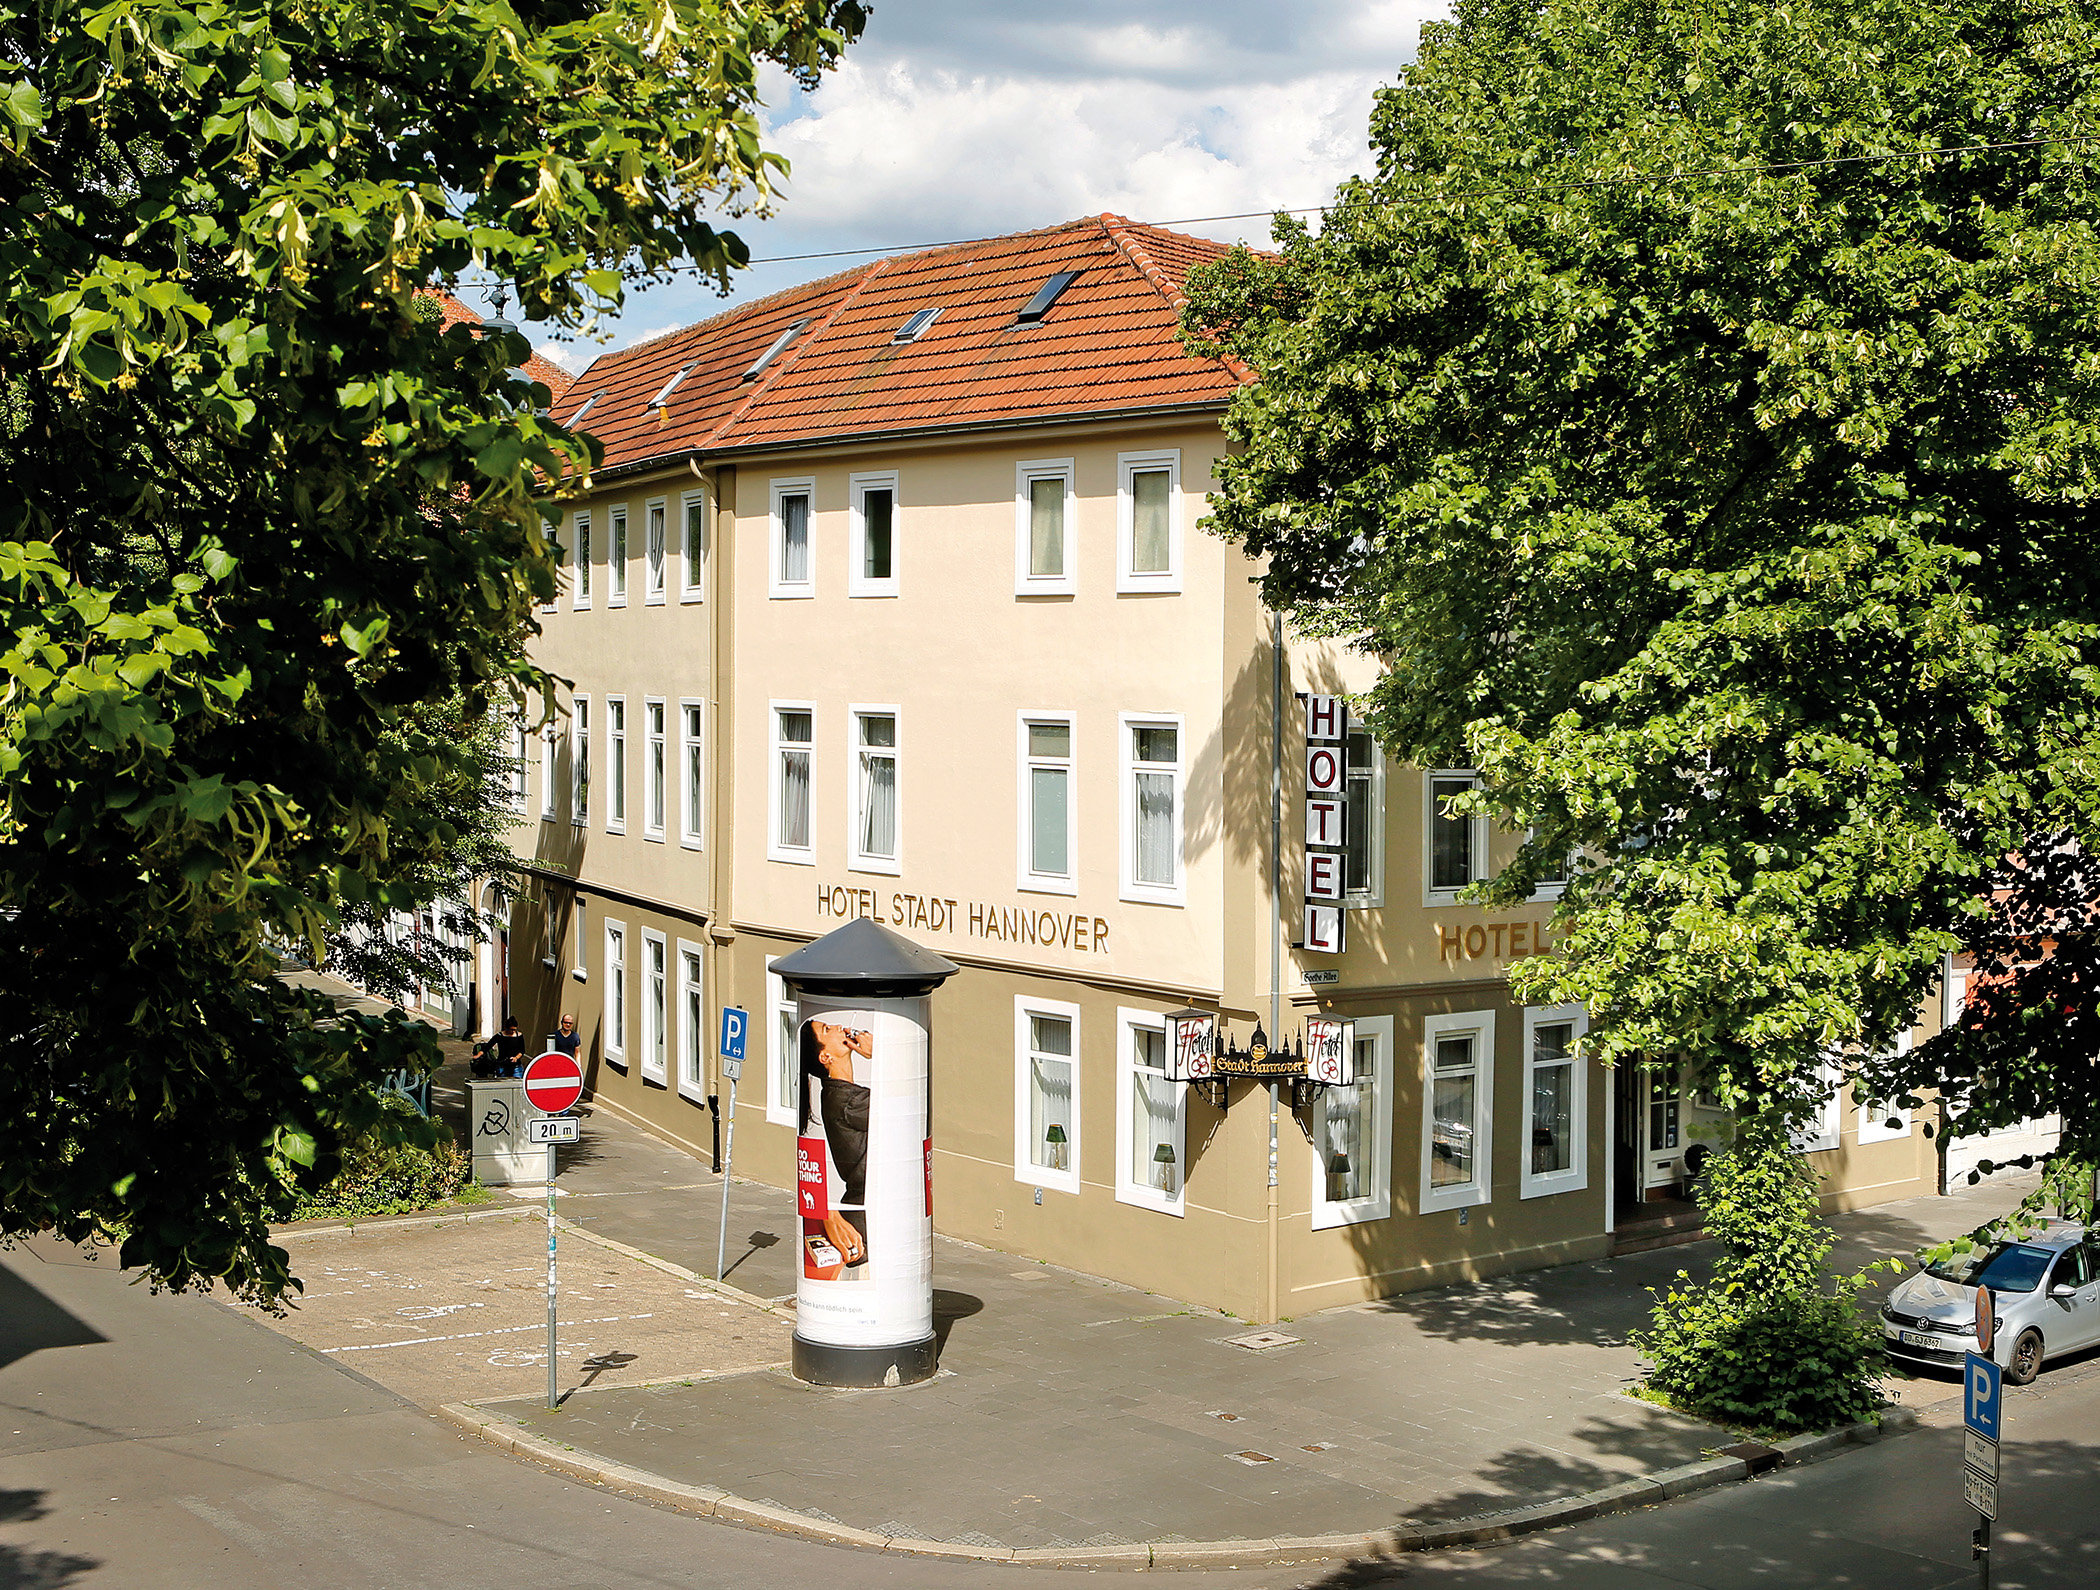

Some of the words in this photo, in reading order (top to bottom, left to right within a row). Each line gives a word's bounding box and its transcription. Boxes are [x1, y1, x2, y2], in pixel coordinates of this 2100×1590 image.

[1310, 697, 1336, 948] HOTEL
[817, 883, 885, 925] HOTEL
[891, 892, 958, 934] STADT
[969, 902, 1110, 954] HANNOVER
[1439, 920, 1551, 961] HOTEL
[726, 1014, 742, 1051] P
[541, 1124, 557, 1138] 20
[563, 1126, 572, 1136] m
[798, 1149, 808, 1161] DO
[799, 1160, 820, 1173] YOUR
[799, 1171, 823, 1184] THING
[1972, 1363, 1992, 1420] P
